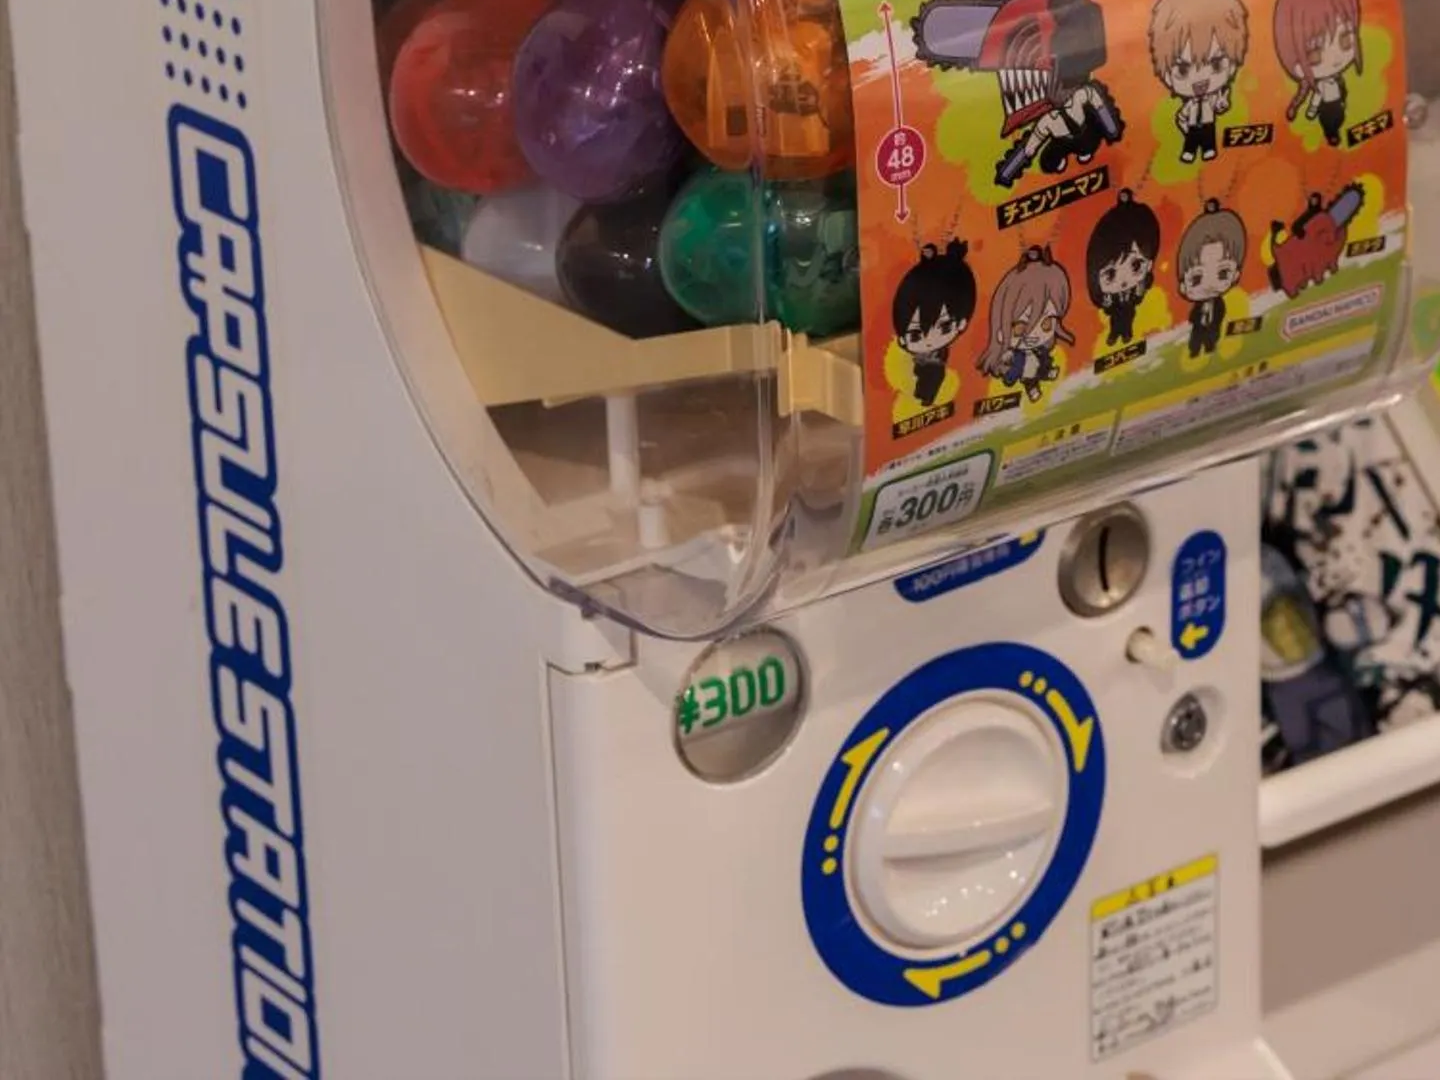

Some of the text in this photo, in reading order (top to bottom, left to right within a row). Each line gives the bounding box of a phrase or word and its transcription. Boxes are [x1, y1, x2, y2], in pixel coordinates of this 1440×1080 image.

[886, 145, 915, 169] 48
[1003, 172, 1104, 225] チェンソーマン
[677, 655, 785, 735] ¥300
